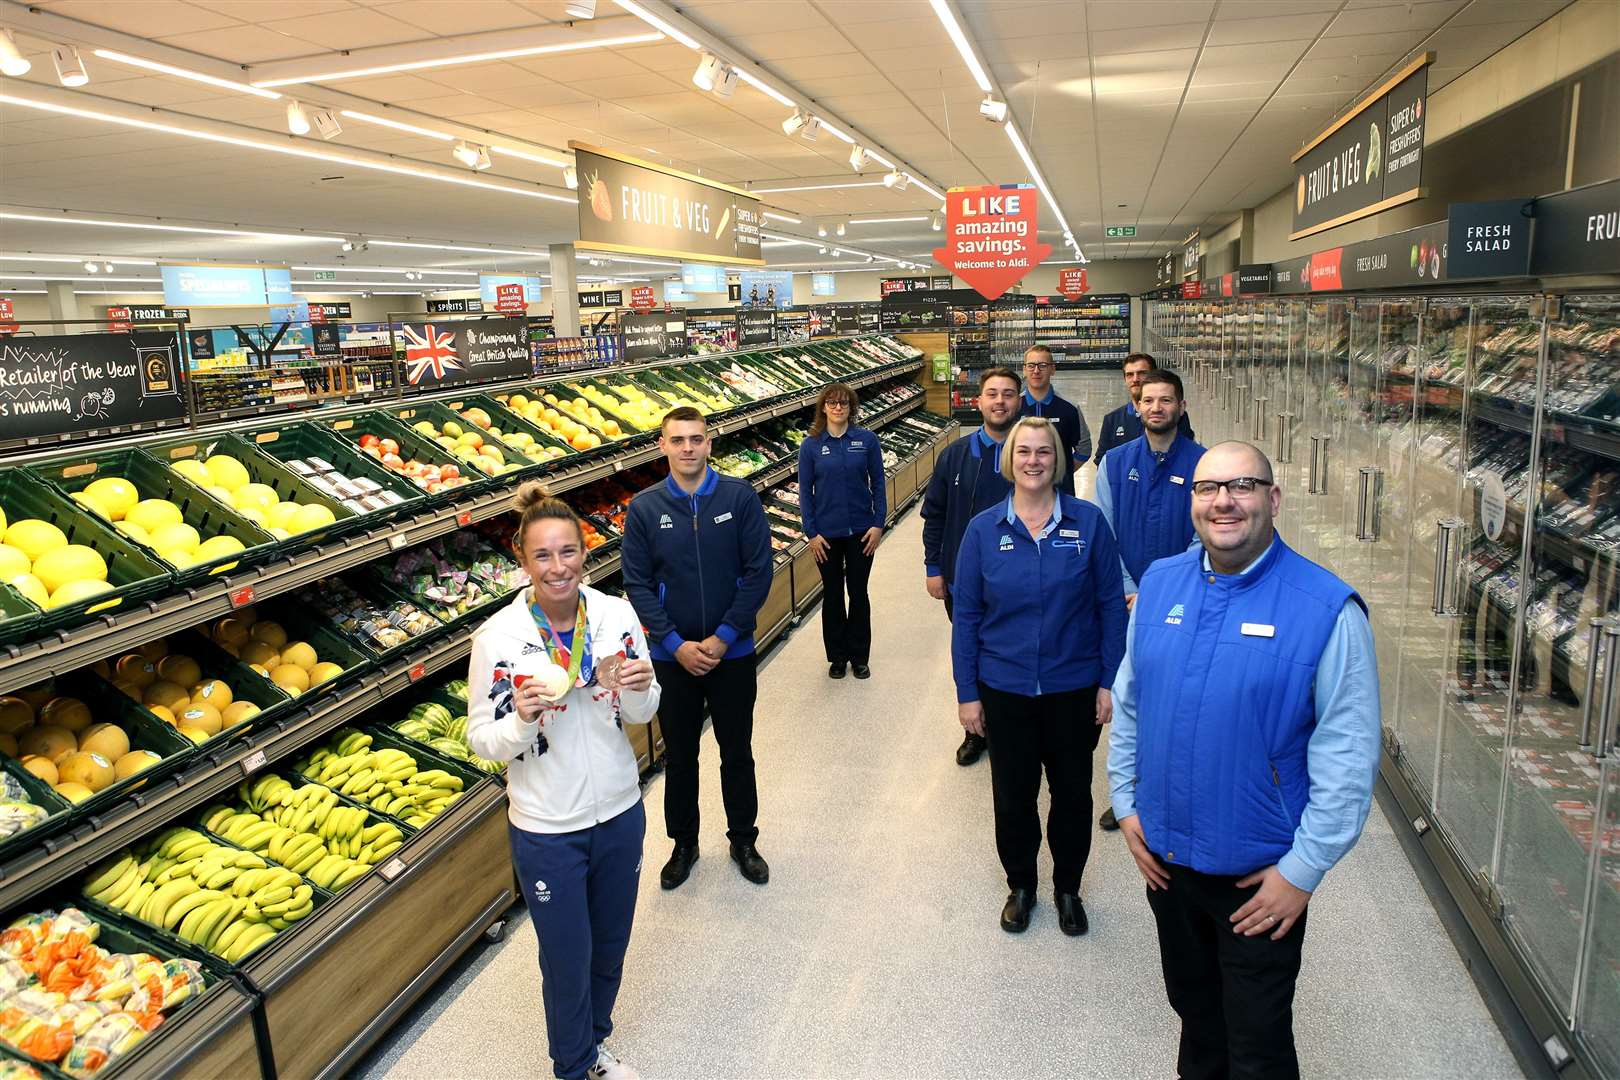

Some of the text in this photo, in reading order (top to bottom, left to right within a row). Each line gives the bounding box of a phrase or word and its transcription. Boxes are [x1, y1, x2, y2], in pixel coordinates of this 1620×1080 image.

[1390, 103, 1415, 134] SUPER 6
[1390, 125, 1421, 155] FRESH OFFERS
[1307, 142, 1361, 206] FRUIT & VEG
[1388, 160, 1399, 174] EVERY
[622, 186, 710, 234] FRUIT & VEG
[962, 195, 1020, 216] LIKE
[956, 217, 1028, 236] amazing
[1468, 224, 1511, 238] FRESH
[957, 236, 1026, 255] savings.
[1466, 239, 1510, 252] SALAD
[954, 258, 1030, 269] Welcome to Aldi.
[1356, 258, 1371, 272] FRESH
[1371, 254, 1388, 270] SALAD
[135, 310, 165, 319] FROZEN
[438, 302, 463, 311] SPIRITS
[479, 331, 517, 346] Championing
[469, 348, 529, 362] Great British Quality
[0, 361, 137, 388] Retailer of the Year
[13, 396, 72, 416] running
